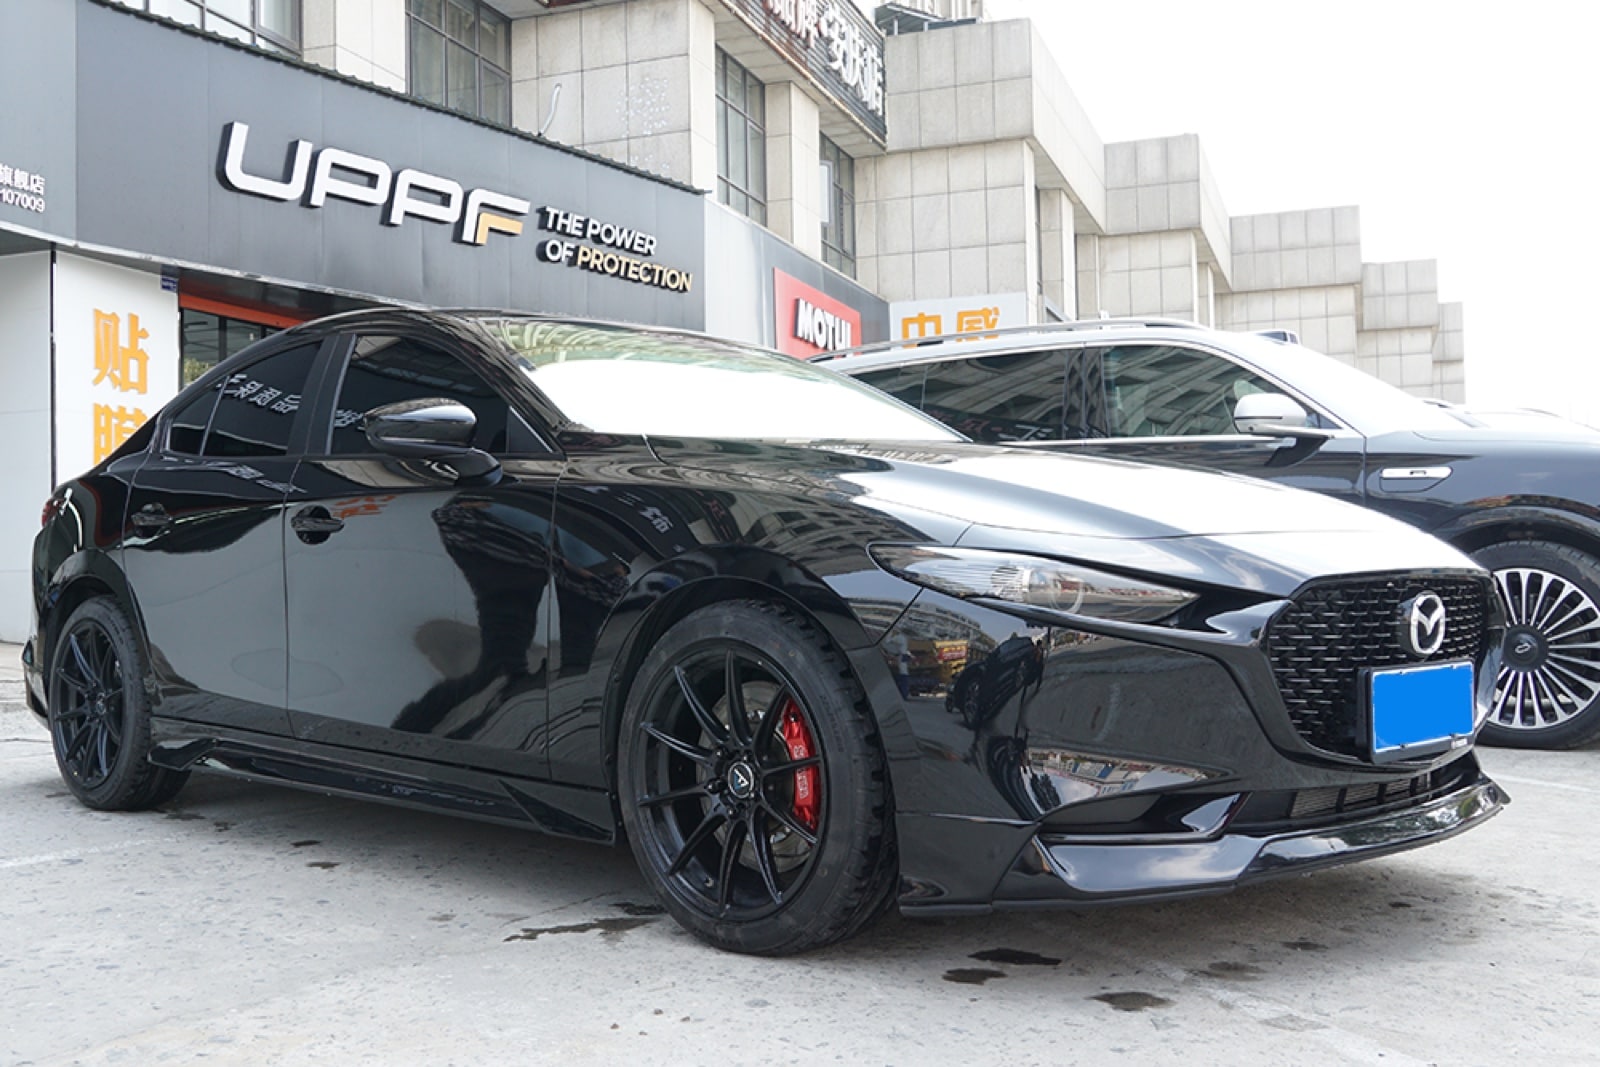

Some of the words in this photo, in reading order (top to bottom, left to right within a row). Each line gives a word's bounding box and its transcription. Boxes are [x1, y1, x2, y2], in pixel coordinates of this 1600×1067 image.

[545, 205, 585, 237] THE
[586, 217, 657, 255] POWER
[545, 239, 575, 262] OF
[576, 245, 693, 292] PROTECTION
